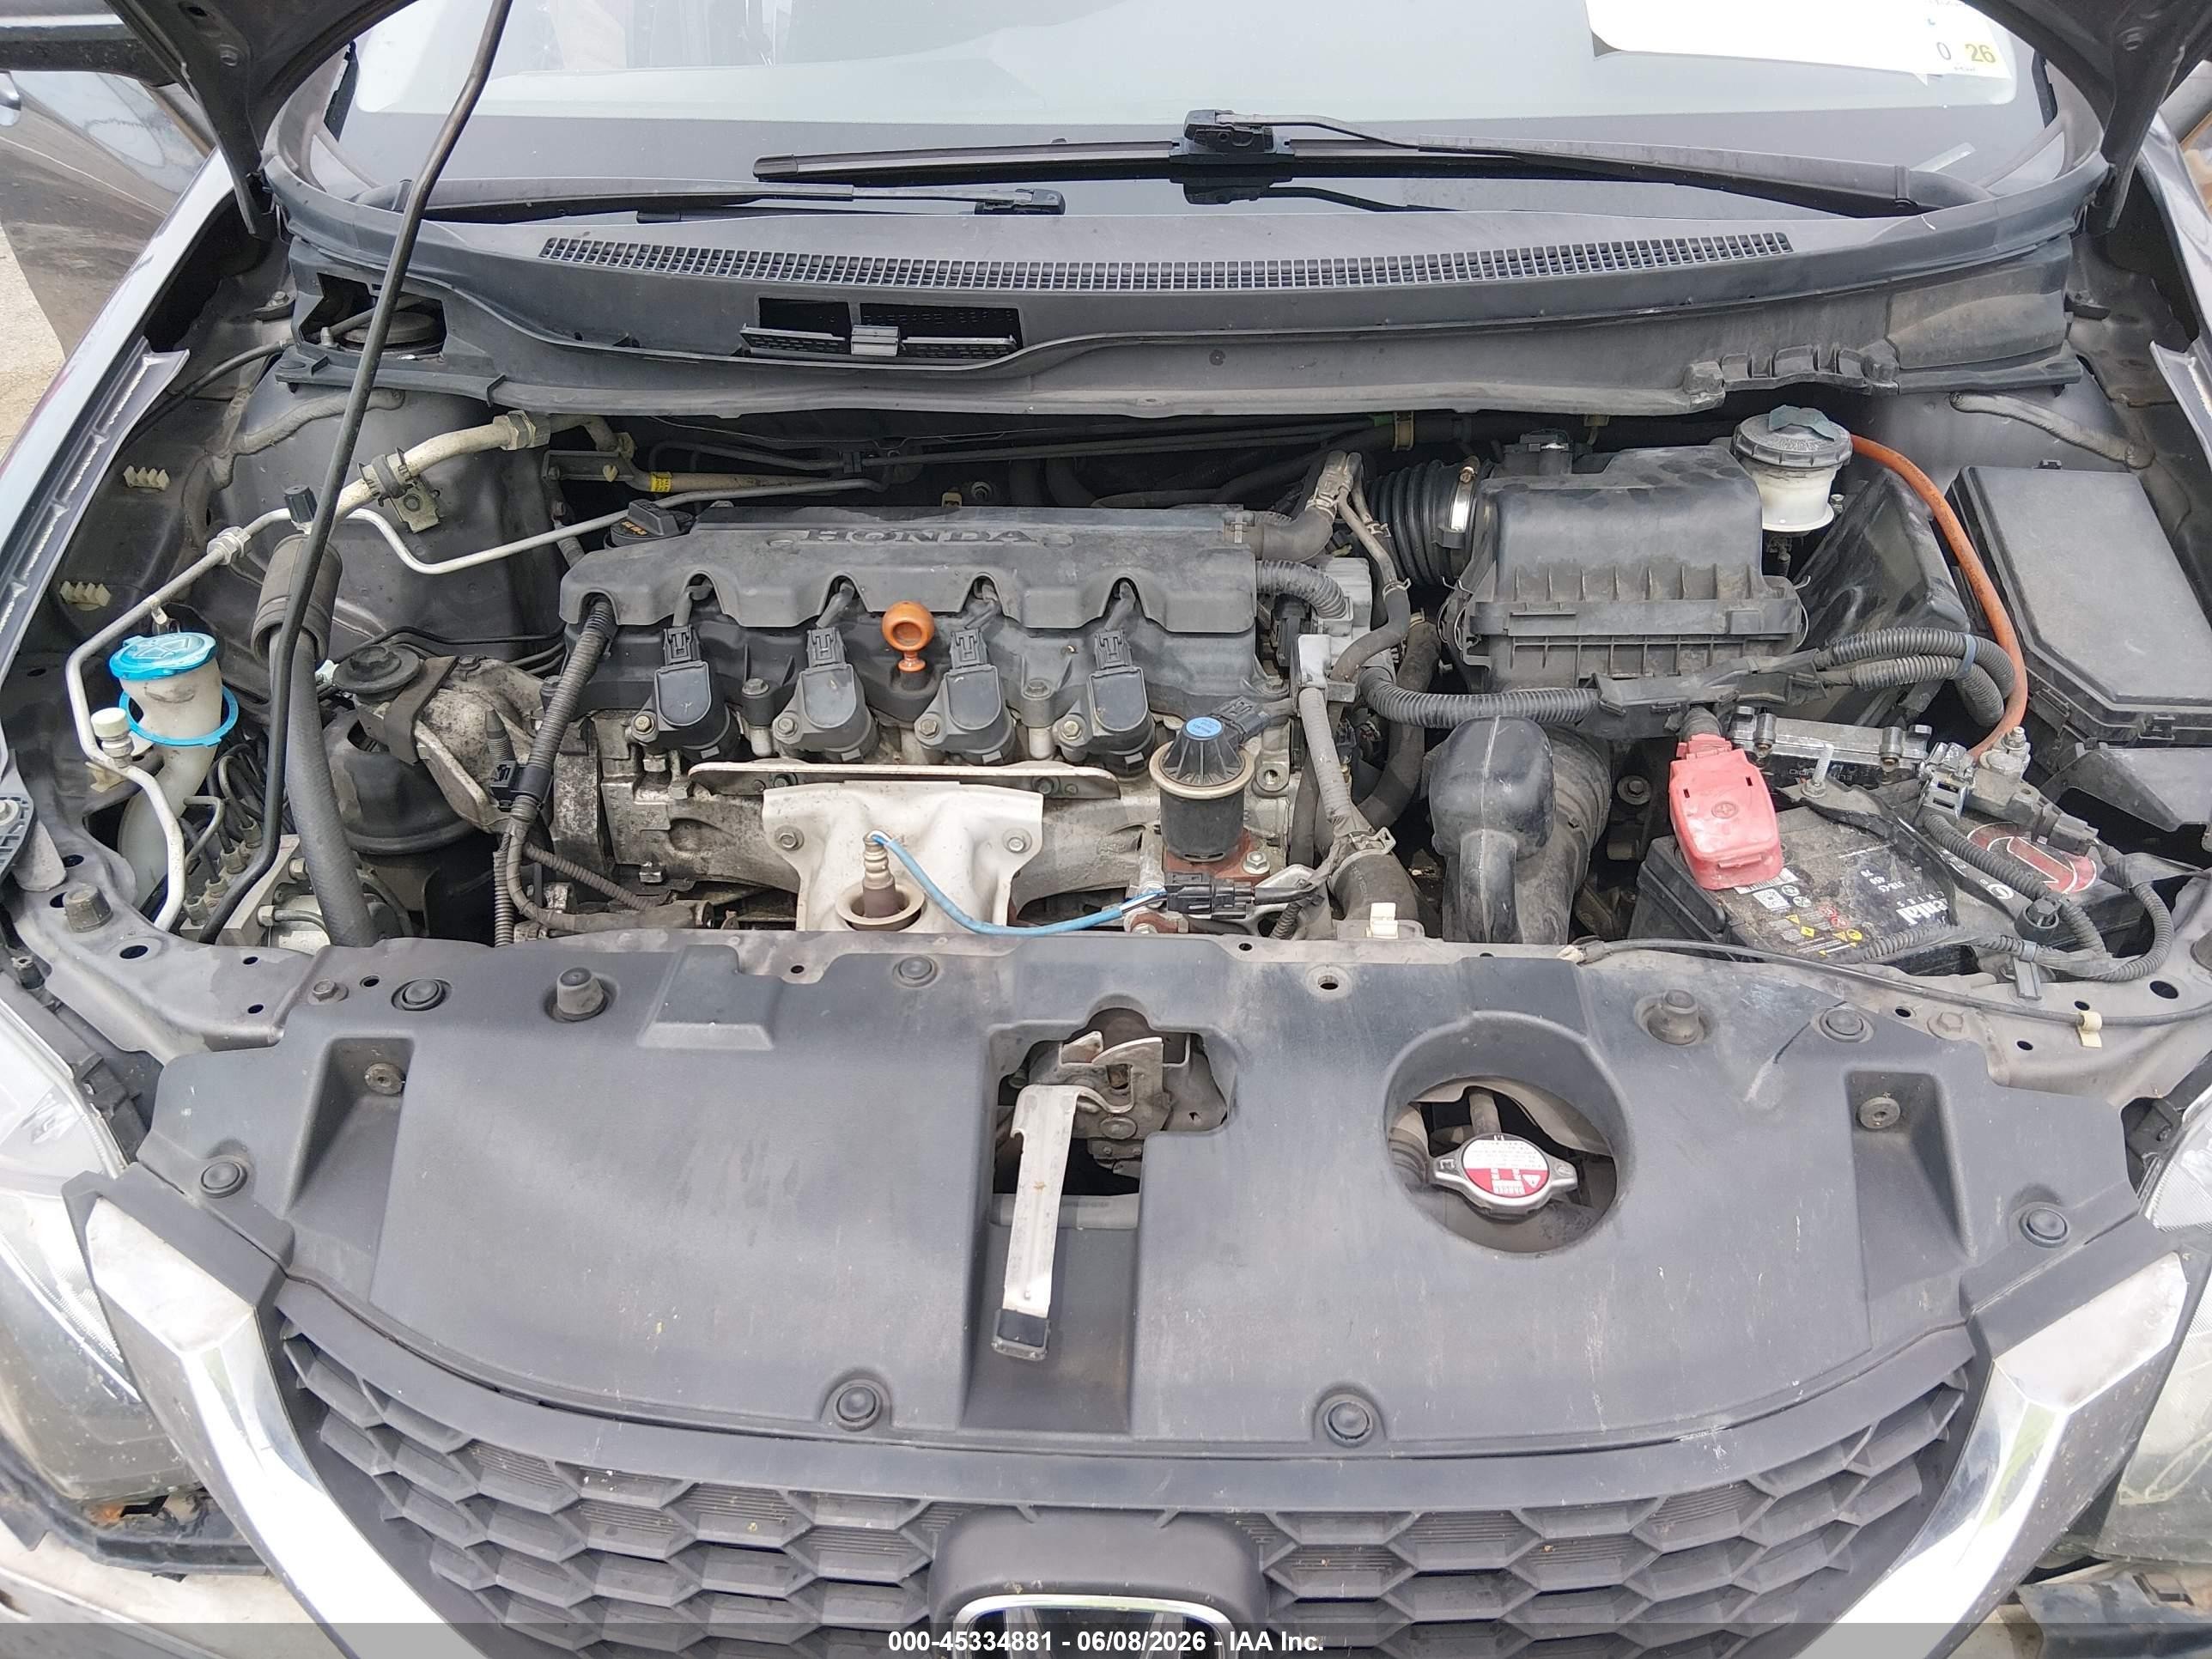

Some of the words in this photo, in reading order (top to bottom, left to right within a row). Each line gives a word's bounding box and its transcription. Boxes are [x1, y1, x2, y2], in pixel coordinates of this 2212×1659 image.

[1965, 43, 1996, 64] 26
[799, 529, 1037, 545] HONDA
[1860, 869, 1875, 878] 70
[1896, 898, 1948, 927] ental
